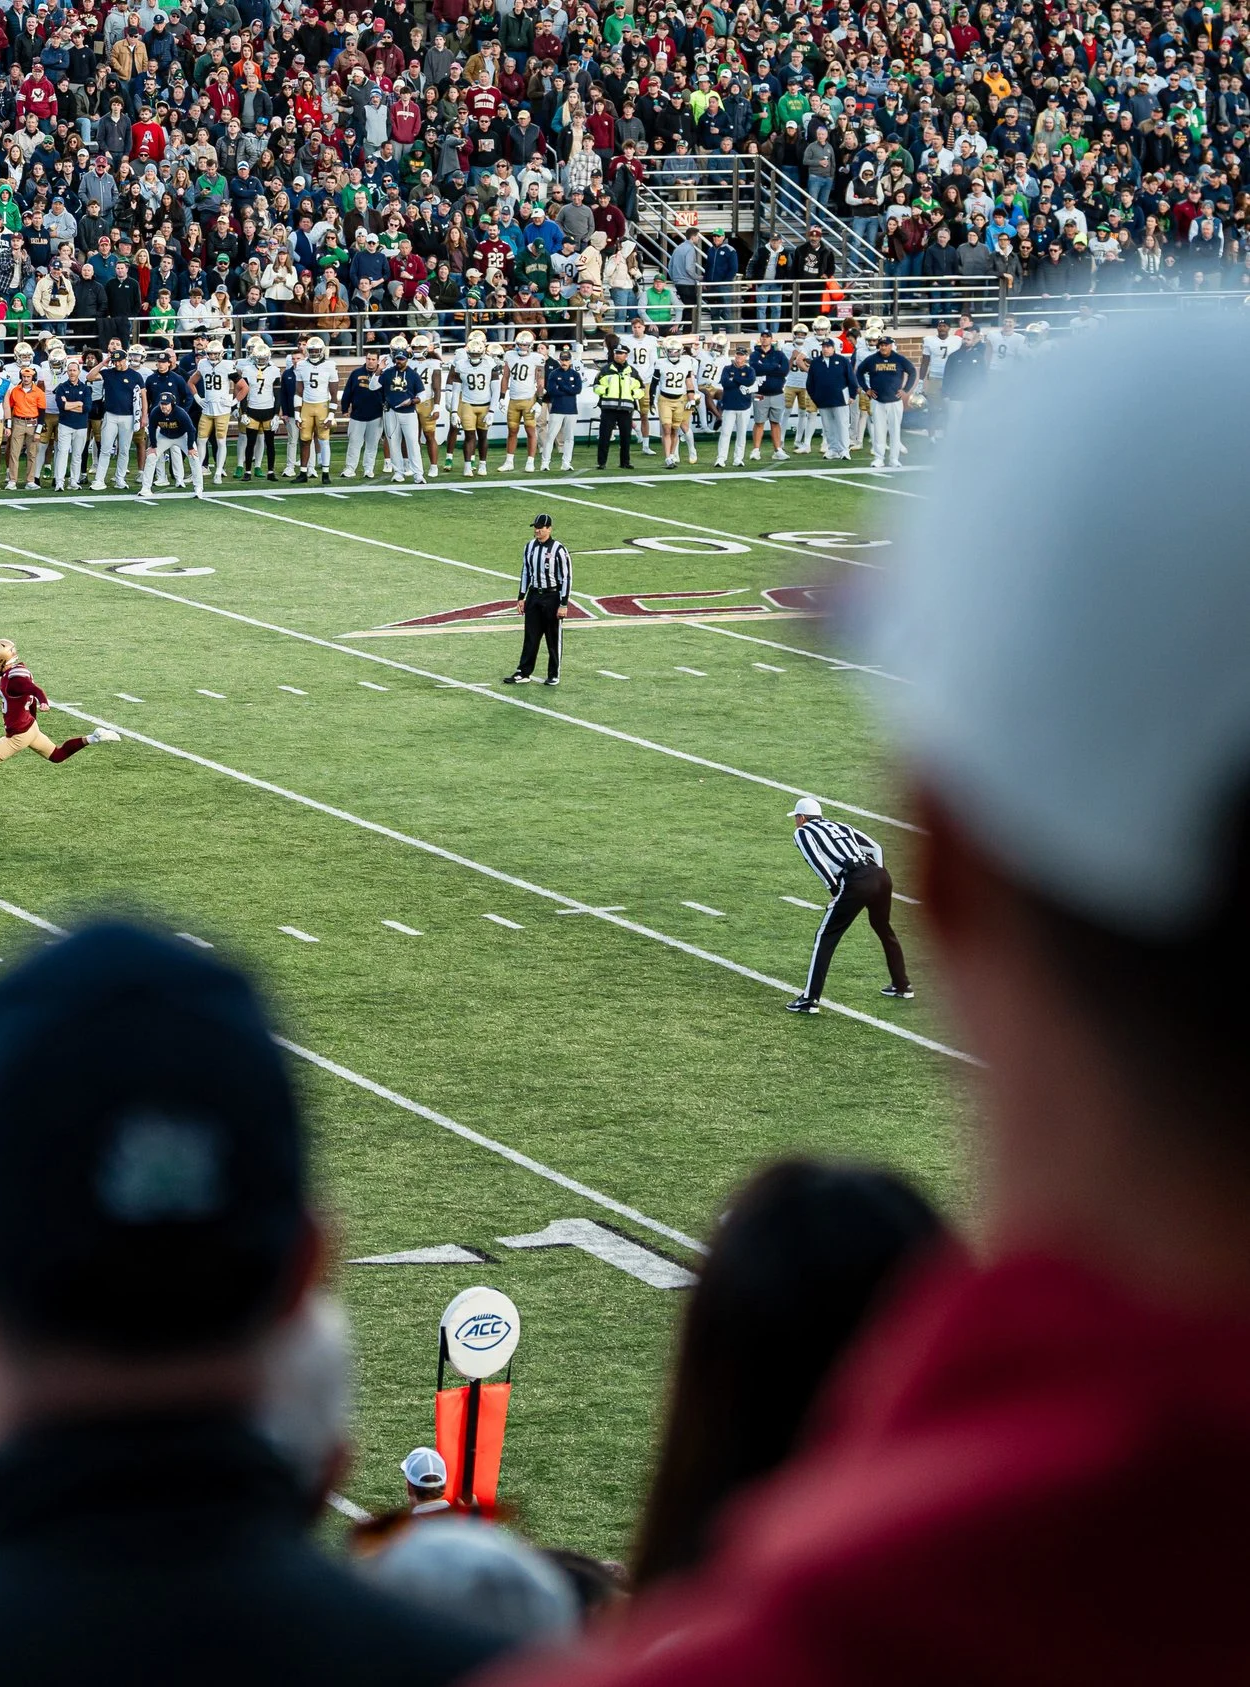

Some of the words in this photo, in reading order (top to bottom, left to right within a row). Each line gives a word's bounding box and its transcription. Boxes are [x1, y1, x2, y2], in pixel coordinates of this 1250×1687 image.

[487, 253, 504, 267] 22
[160, 319, 168, 331] 7
[633, 348, 647, 365] 16
[940, 346, 947, 359] 7
[310, 372, 319, 389] 5
[510, 363, 528, 381] 40
[665, 371, 684, 388] 22
[702, 364, 718, 381] 21
[205, 373, 222, 390] 28
[256, 378, 265, 394] 7
[466, 373, 486, 390] 93
[495, 1218, 701, 1290] 1
[463, 1321, 503, 1338] ACC
